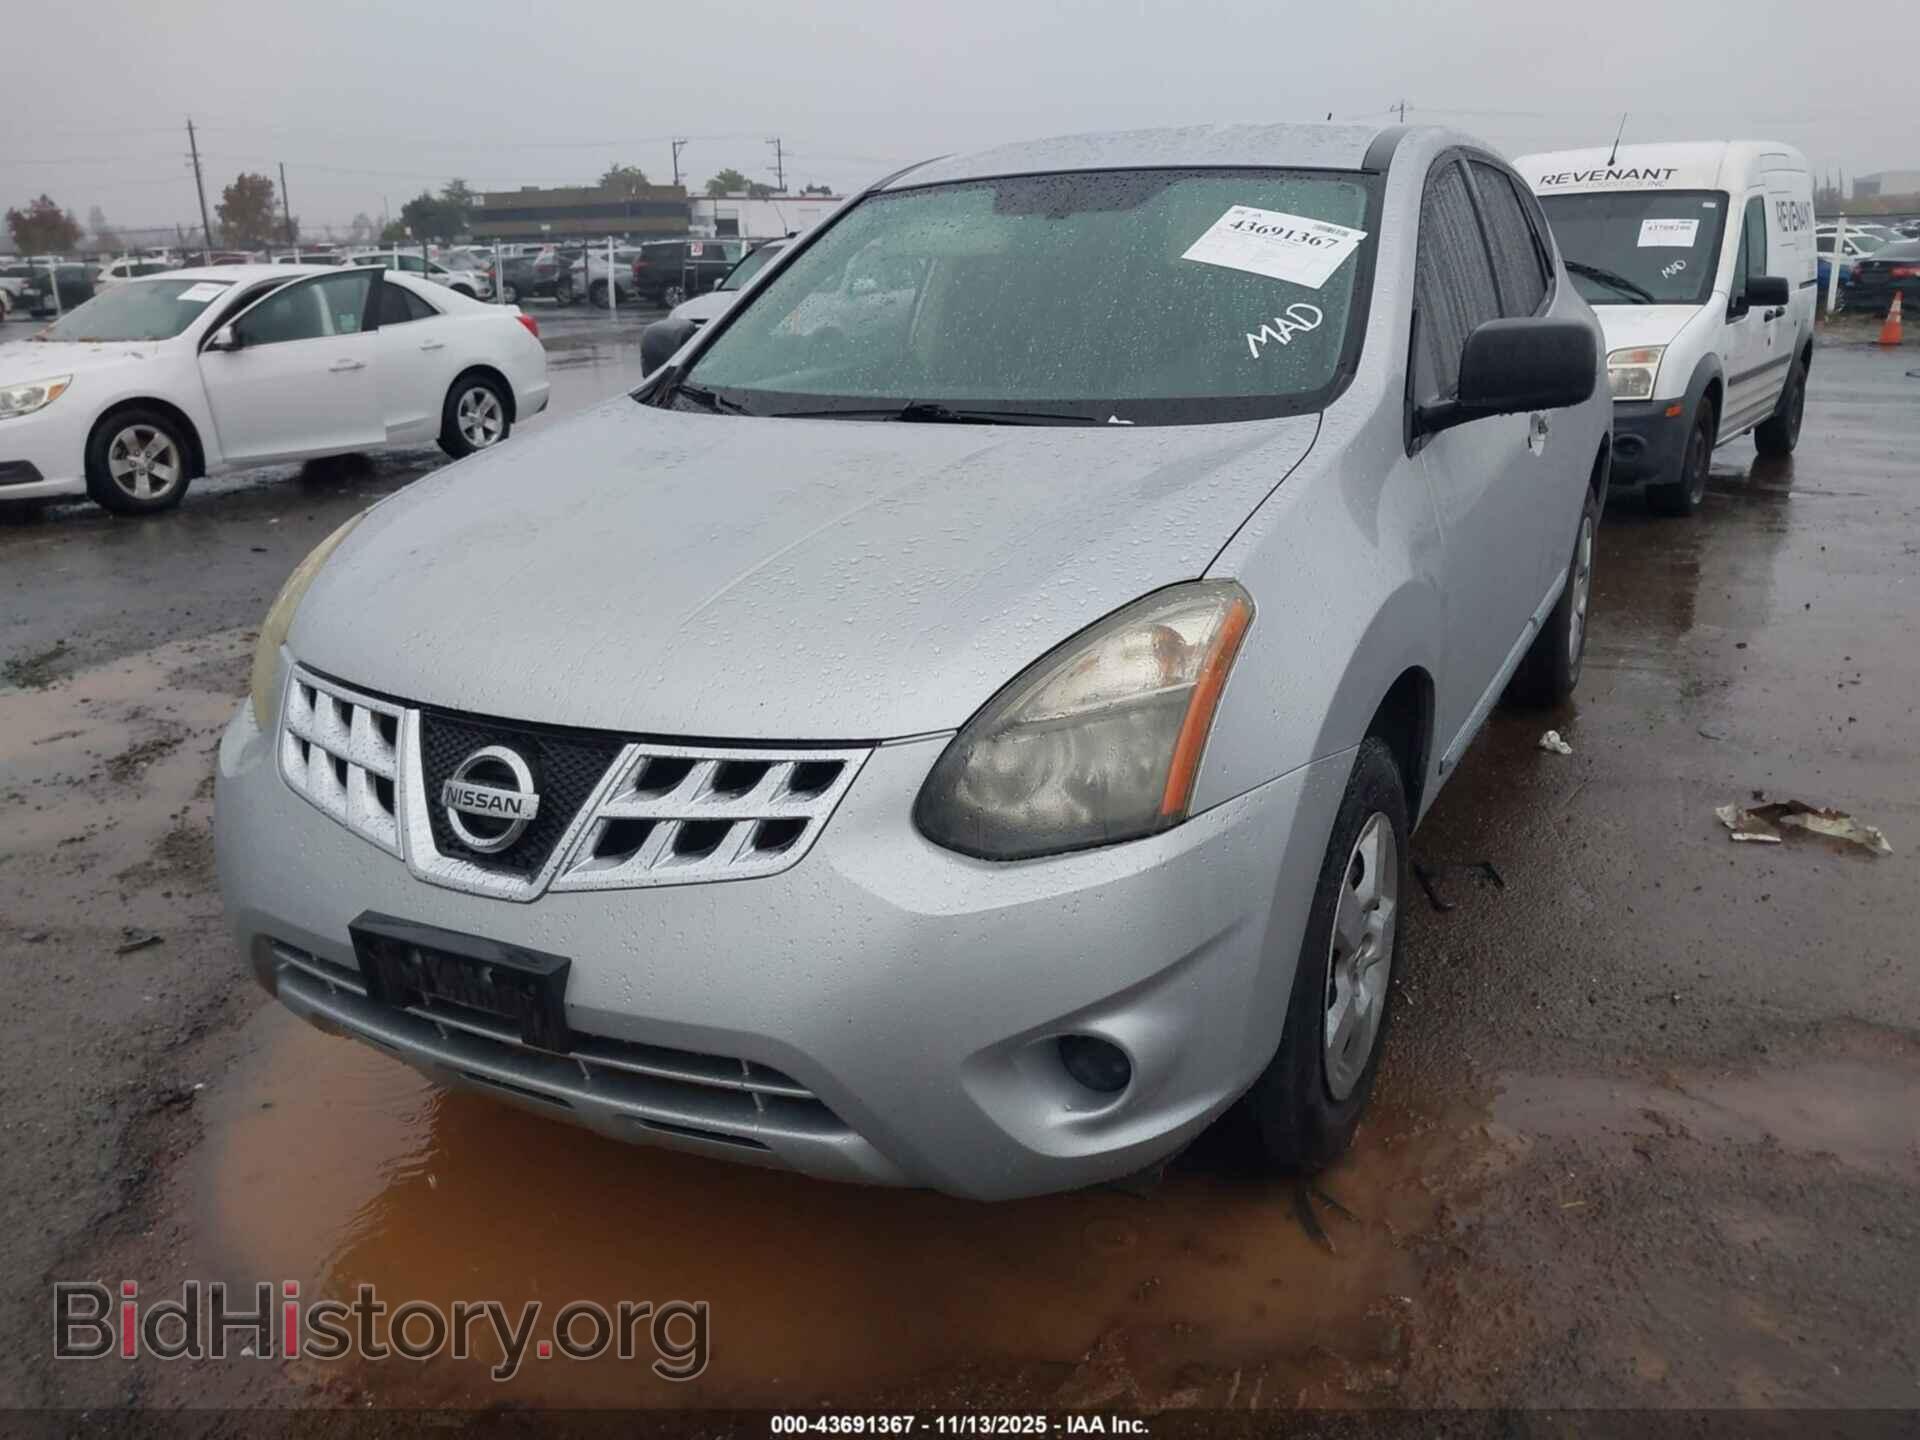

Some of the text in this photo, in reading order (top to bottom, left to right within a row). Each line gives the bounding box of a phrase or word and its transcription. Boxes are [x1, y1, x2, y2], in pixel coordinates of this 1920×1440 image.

[1540, 168, 1679, 185] REVENANT
[1229, 220, 1340, 249] 43691367
[1246, 303, 1323, 359] MAD
[446, 786, 522, 814] NISSAN
